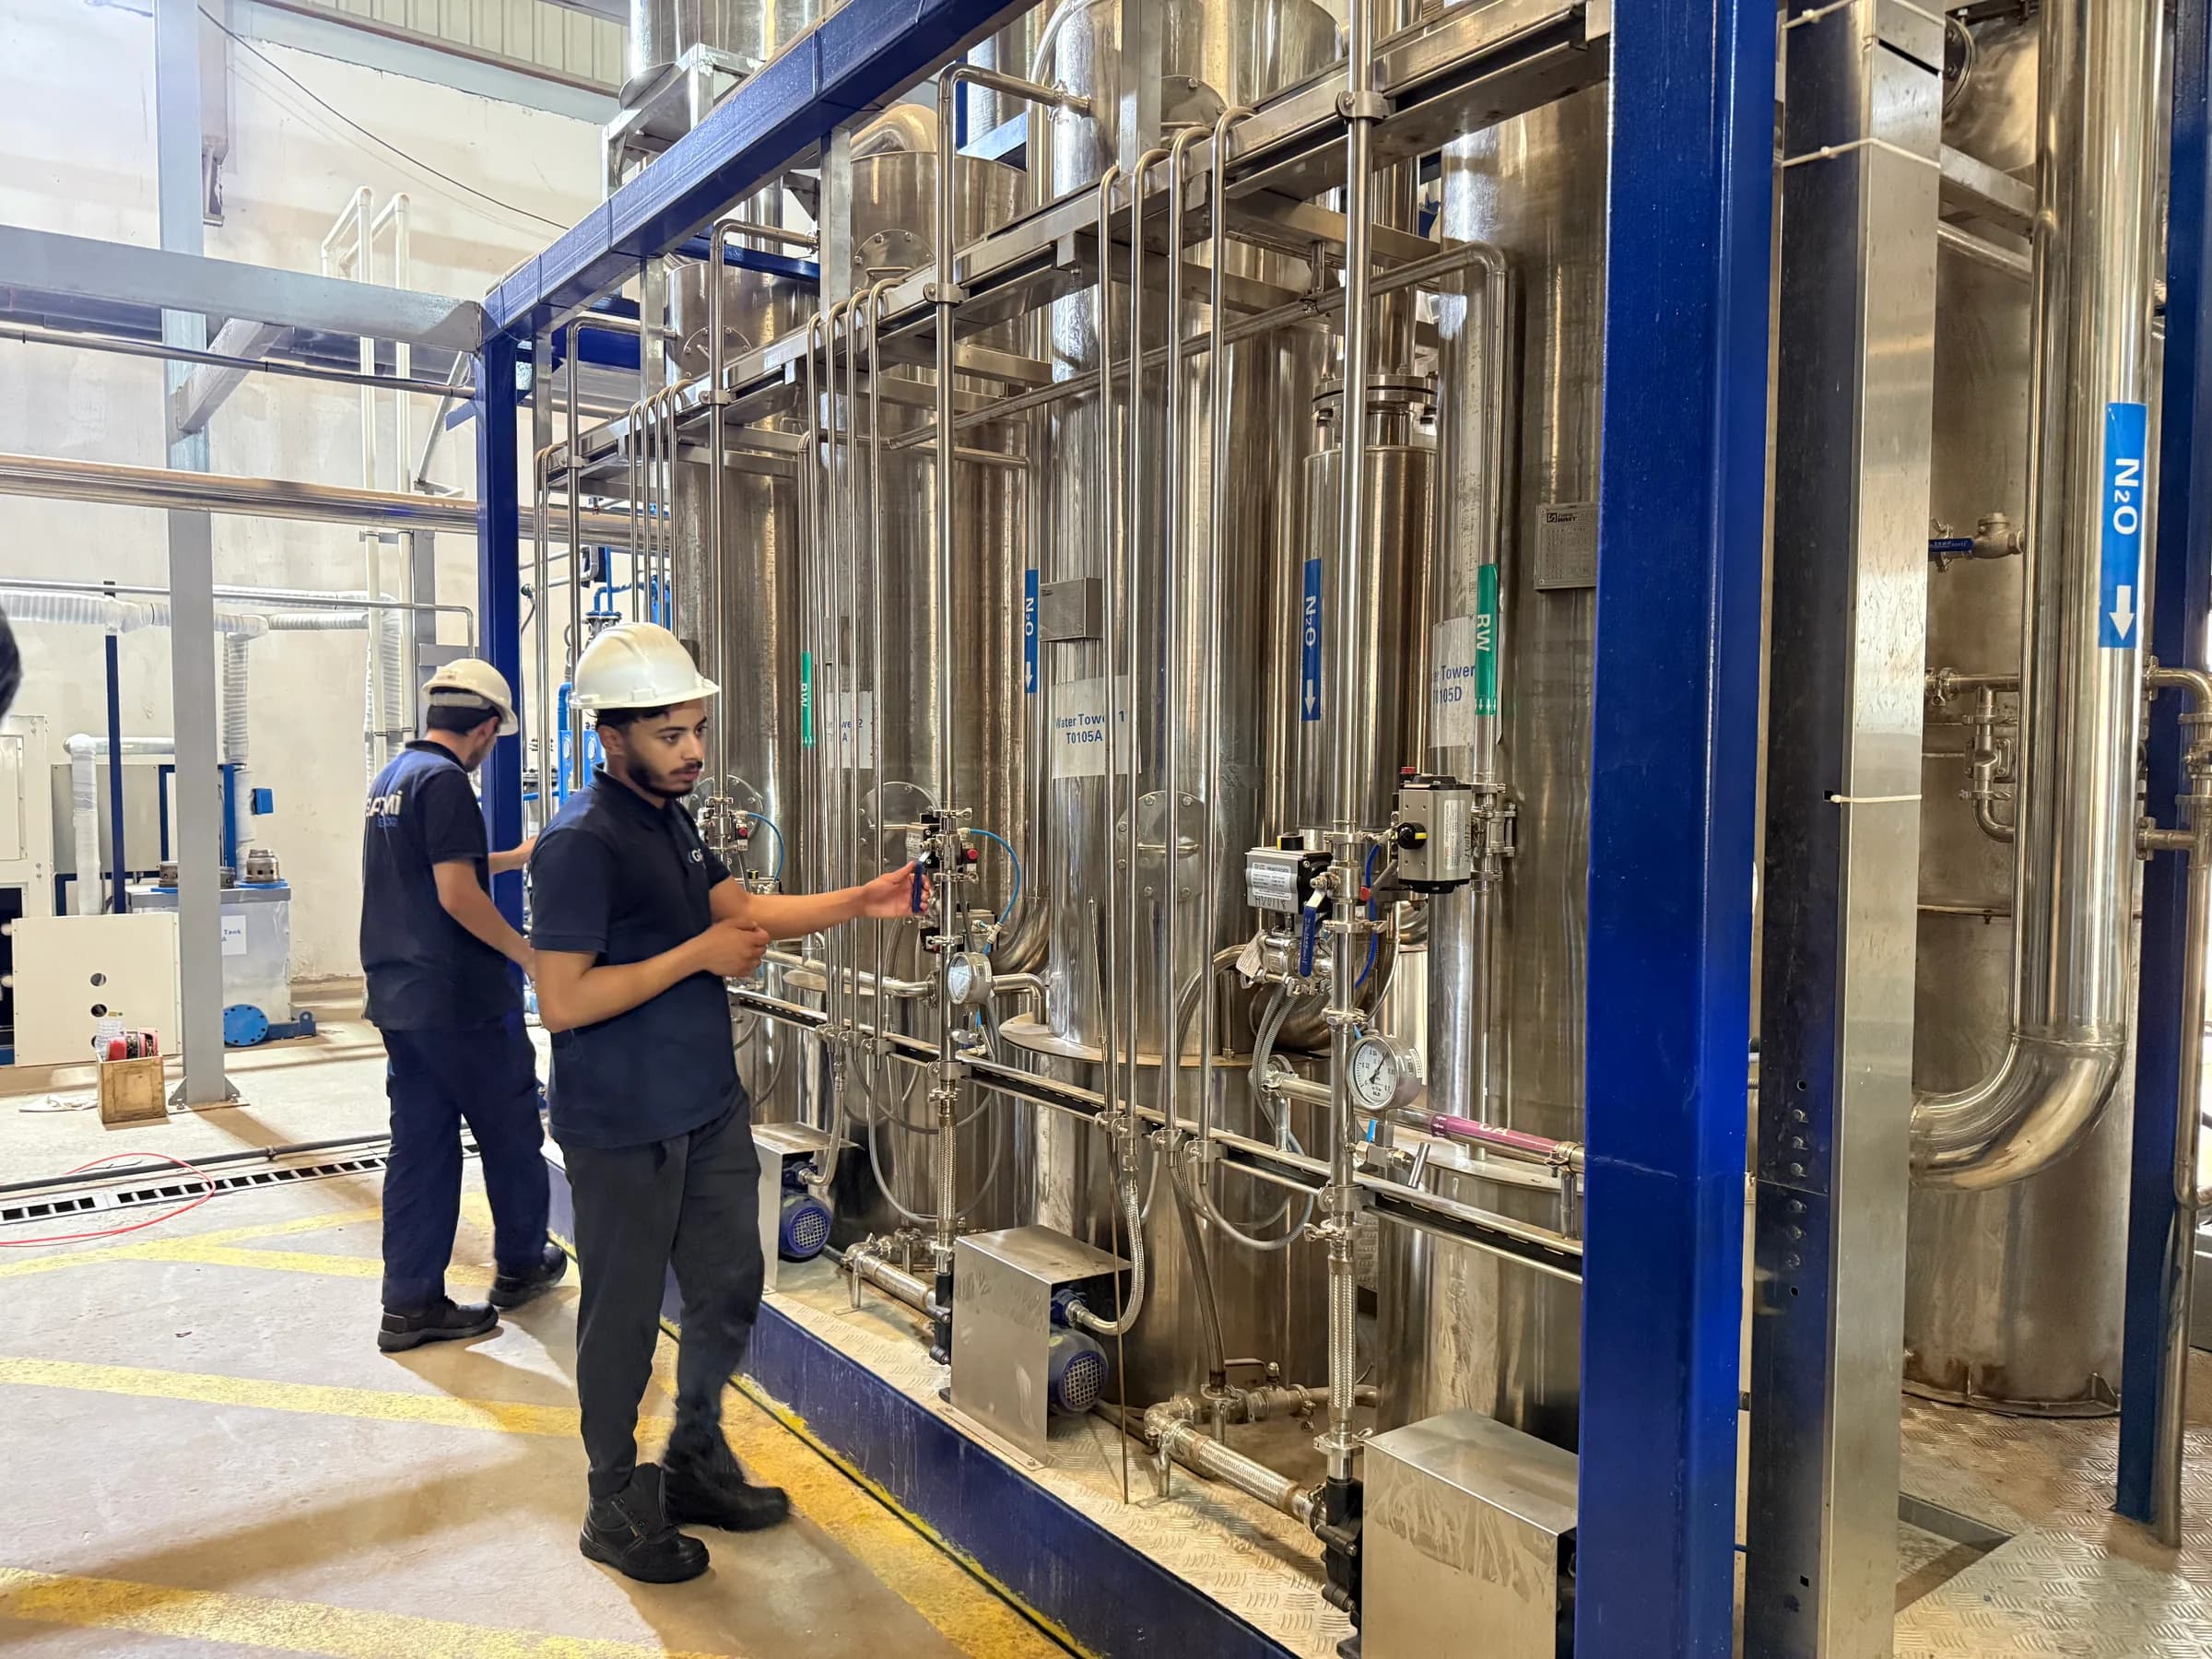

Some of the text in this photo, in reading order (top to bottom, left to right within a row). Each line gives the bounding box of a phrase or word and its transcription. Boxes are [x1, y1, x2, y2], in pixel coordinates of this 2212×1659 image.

[1477, 614, 1490, 652] RW
[1119, 711, 1125, 723] 1
[1066, 730, 1103, 745] T0105A
